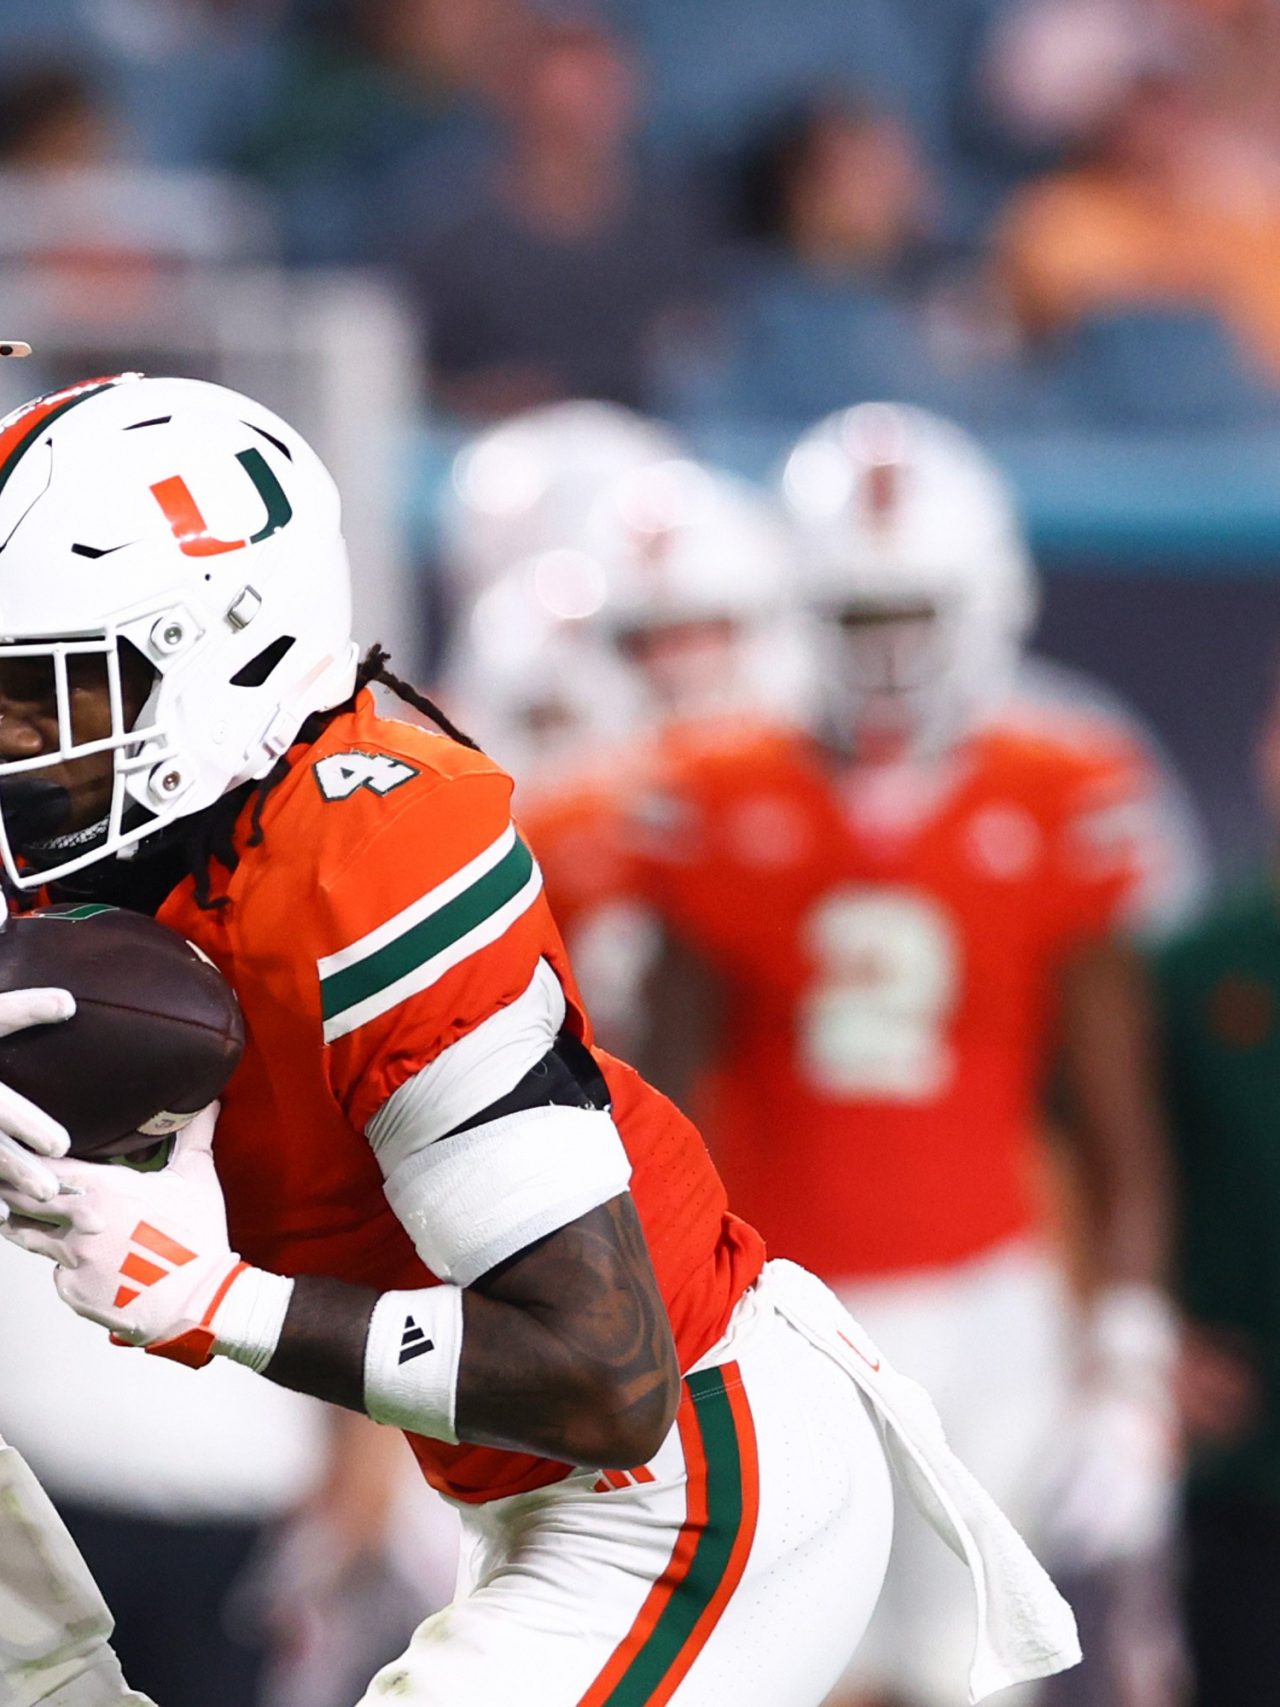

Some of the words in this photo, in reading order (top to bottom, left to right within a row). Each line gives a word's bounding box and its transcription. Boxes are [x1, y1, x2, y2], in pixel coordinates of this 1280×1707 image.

[149, 447, 292, 557] U
[312, 751, 420, 802] 4
[797, 884, 962, 1103] 2
